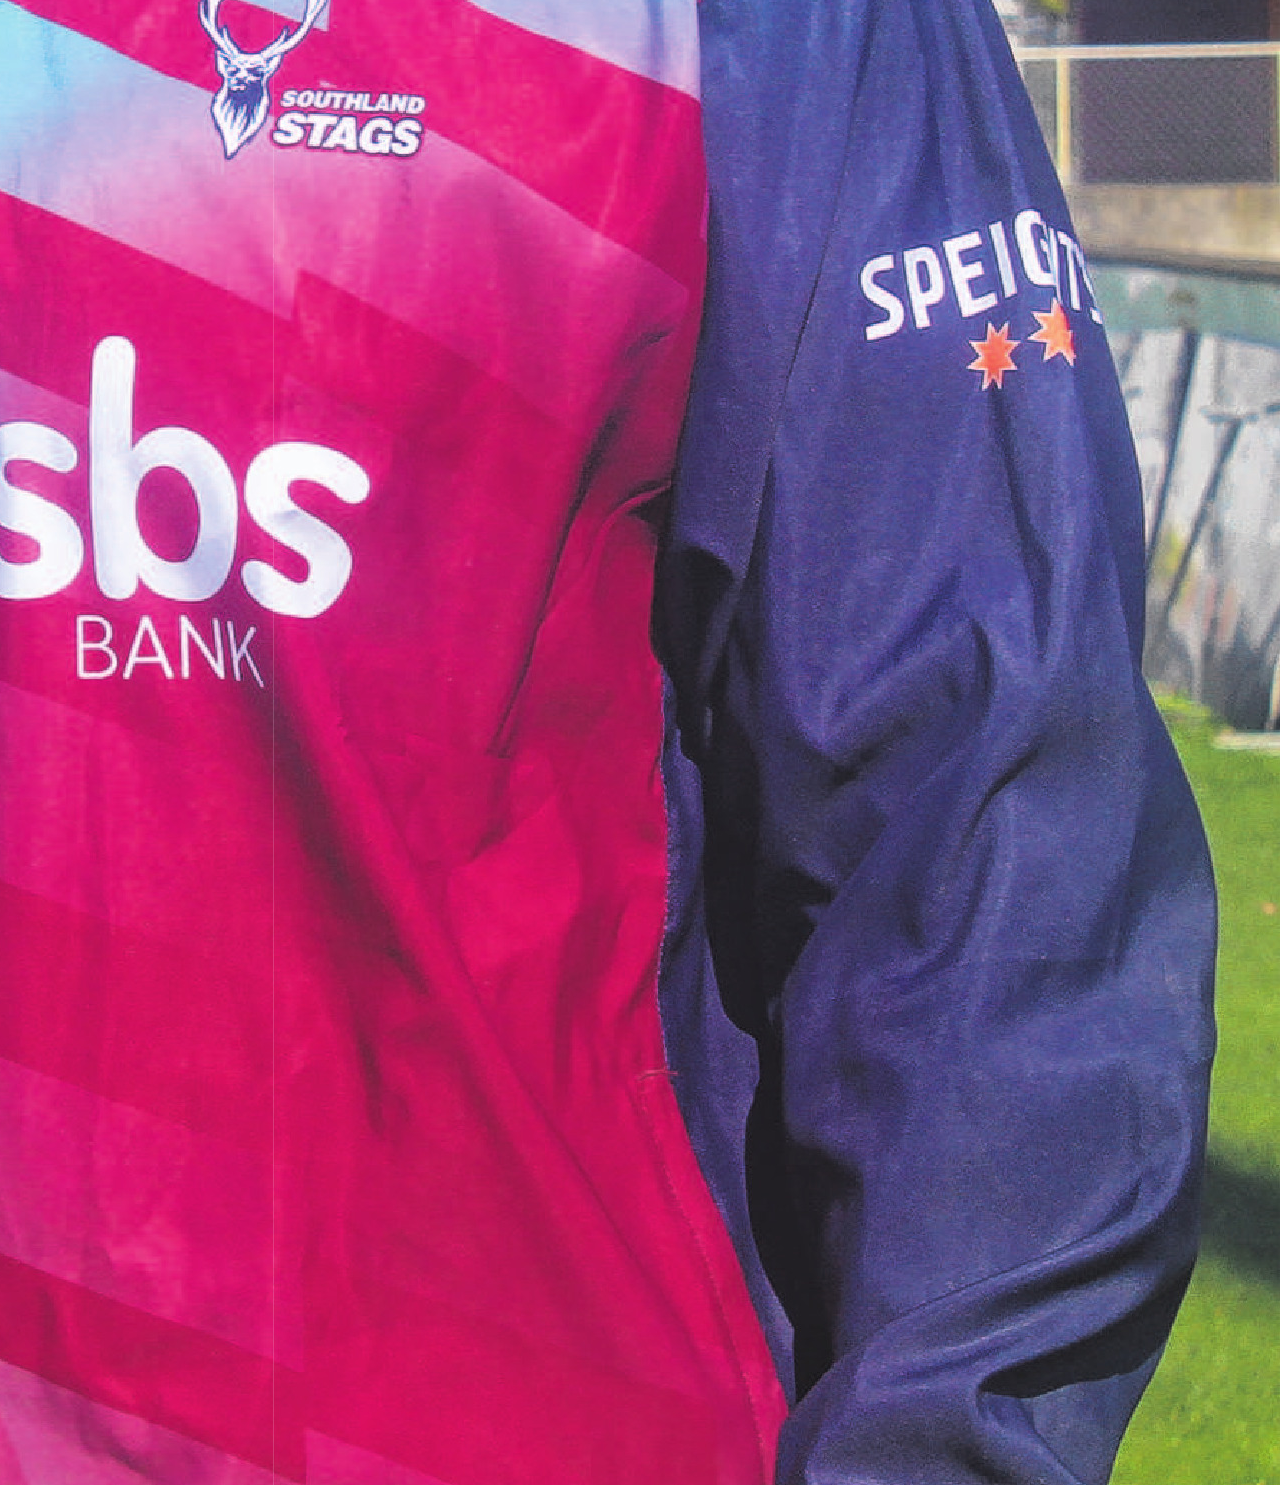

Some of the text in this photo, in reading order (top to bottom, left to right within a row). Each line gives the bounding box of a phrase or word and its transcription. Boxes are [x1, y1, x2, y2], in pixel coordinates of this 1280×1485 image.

[279, 89, 426, 115] SOUTHLAND
[272, 111, 424, 157] STAGS
[75, 615, 265, 688] BANK
